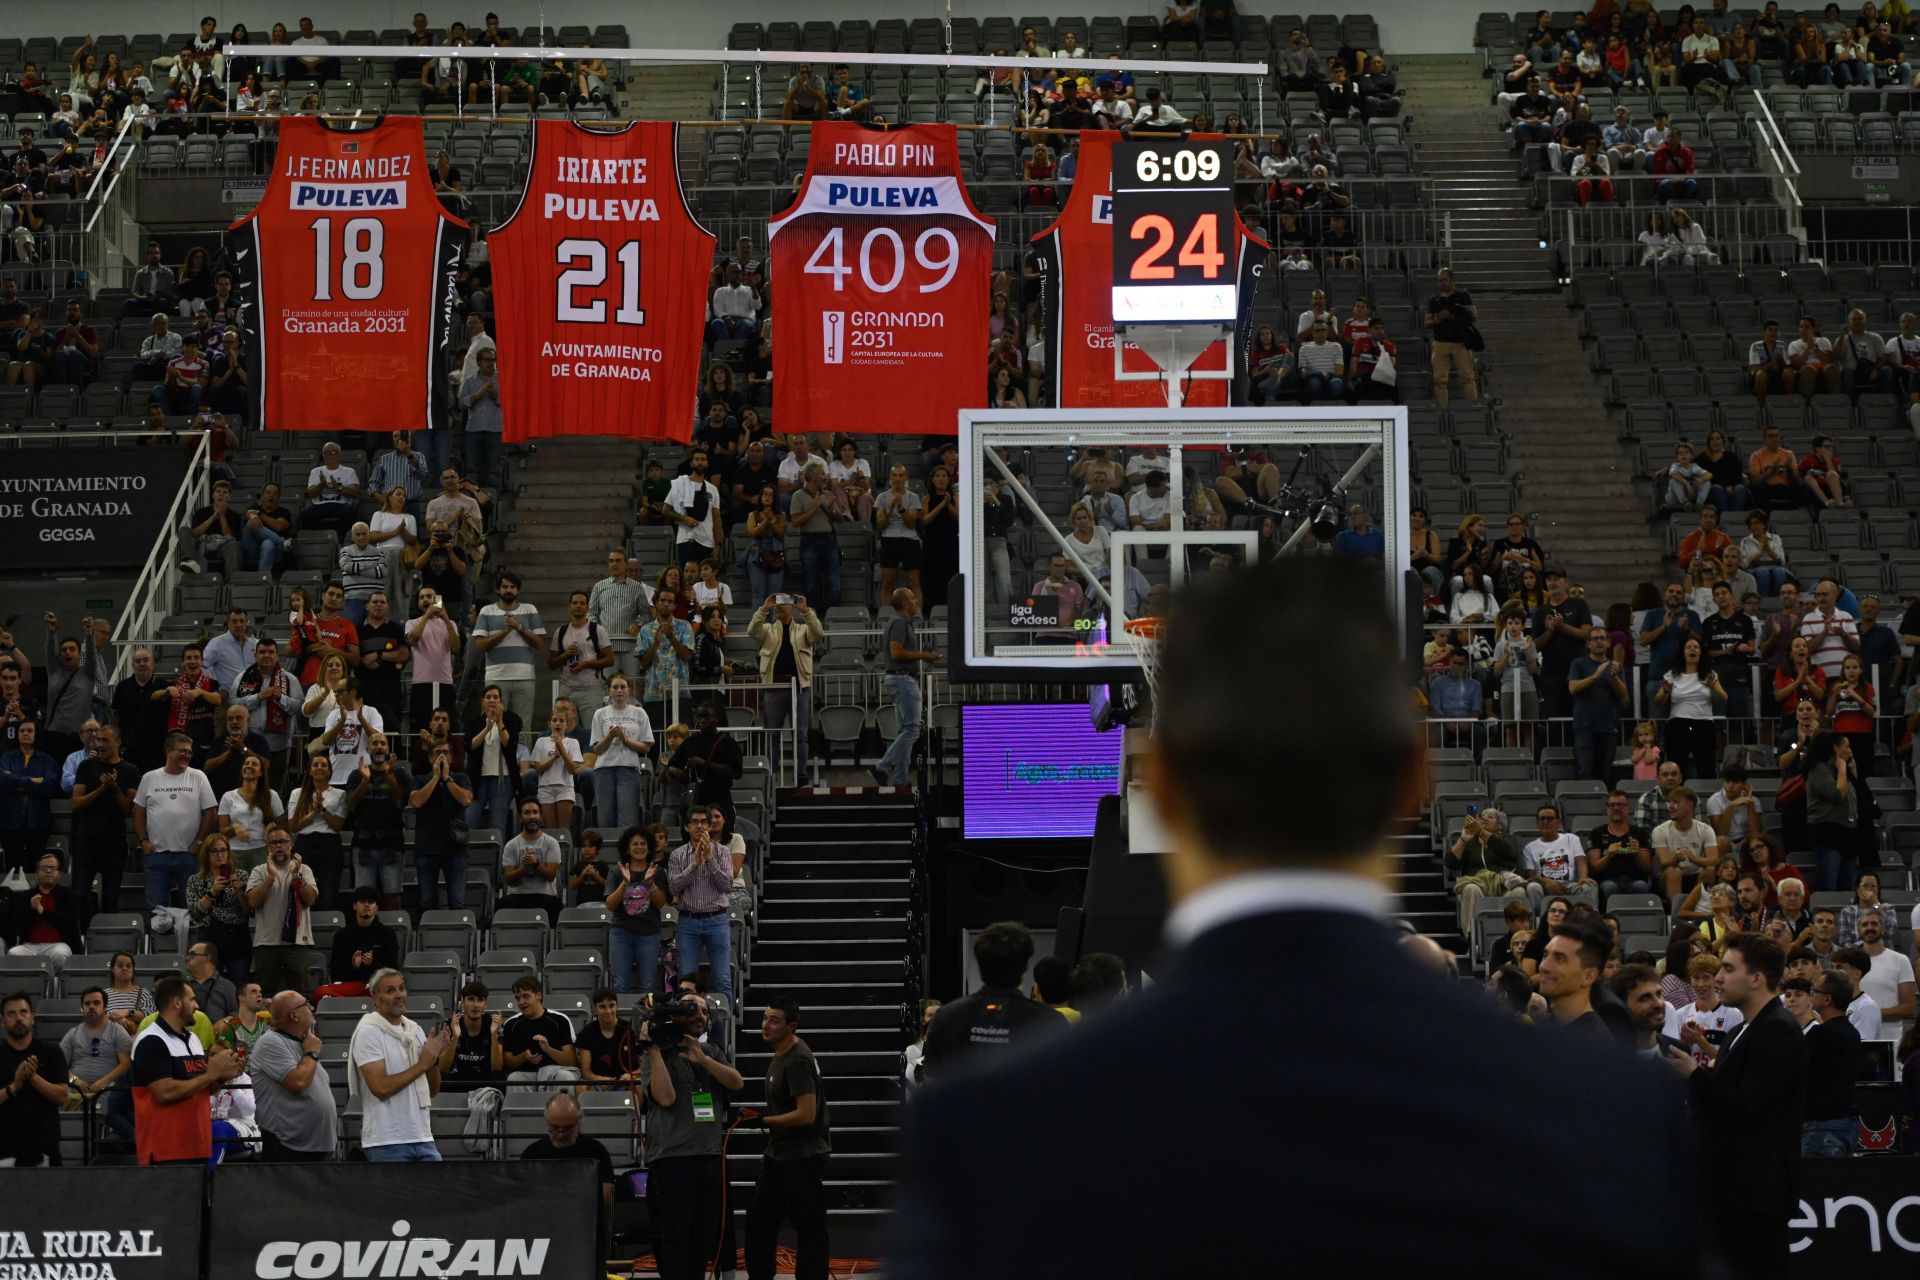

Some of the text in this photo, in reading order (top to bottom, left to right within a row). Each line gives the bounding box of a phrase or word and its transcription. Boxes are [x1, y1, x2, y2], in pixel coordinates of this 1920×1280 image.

[834, 143, 935, 167] PABLO PIN
[1136, 150, 1220, 181] 6:09
[557, 156, 647, 184] IRIARTE
[296, 185, 400, 207] PULEVA
[829, 183, 938, 208] PULEVA
[544, 193, 660, 221] PULEVA
[1130, 213, 1225, 280] 24
[309, 217, 384, 301] 18
[803, 227, 960, 294] 409
[556, 237, 645, 326] 21
[282, 309, 290, 317] El
[350, 309, 377, 317] ciudad
[378, 308, 409, 317] cultural
[284, 317, 407, 333] Granada 2031
[851, 331, 893, 348] 2031
[541, 341, 663, 363] AYUNTAMIENTO
[551, 362, 651, 382] DE GRANADA
[0, 476, 147, 493] YUNTAMIENTO
[31, 497, 133, 518] GRANADA
[1011, 603, 1032, 616] liga
[1011, 615, 1057, 625] endesa
[42, 1230, 163, 1258] RURAL
[0, 1262, 117, 1280] GRANADA
